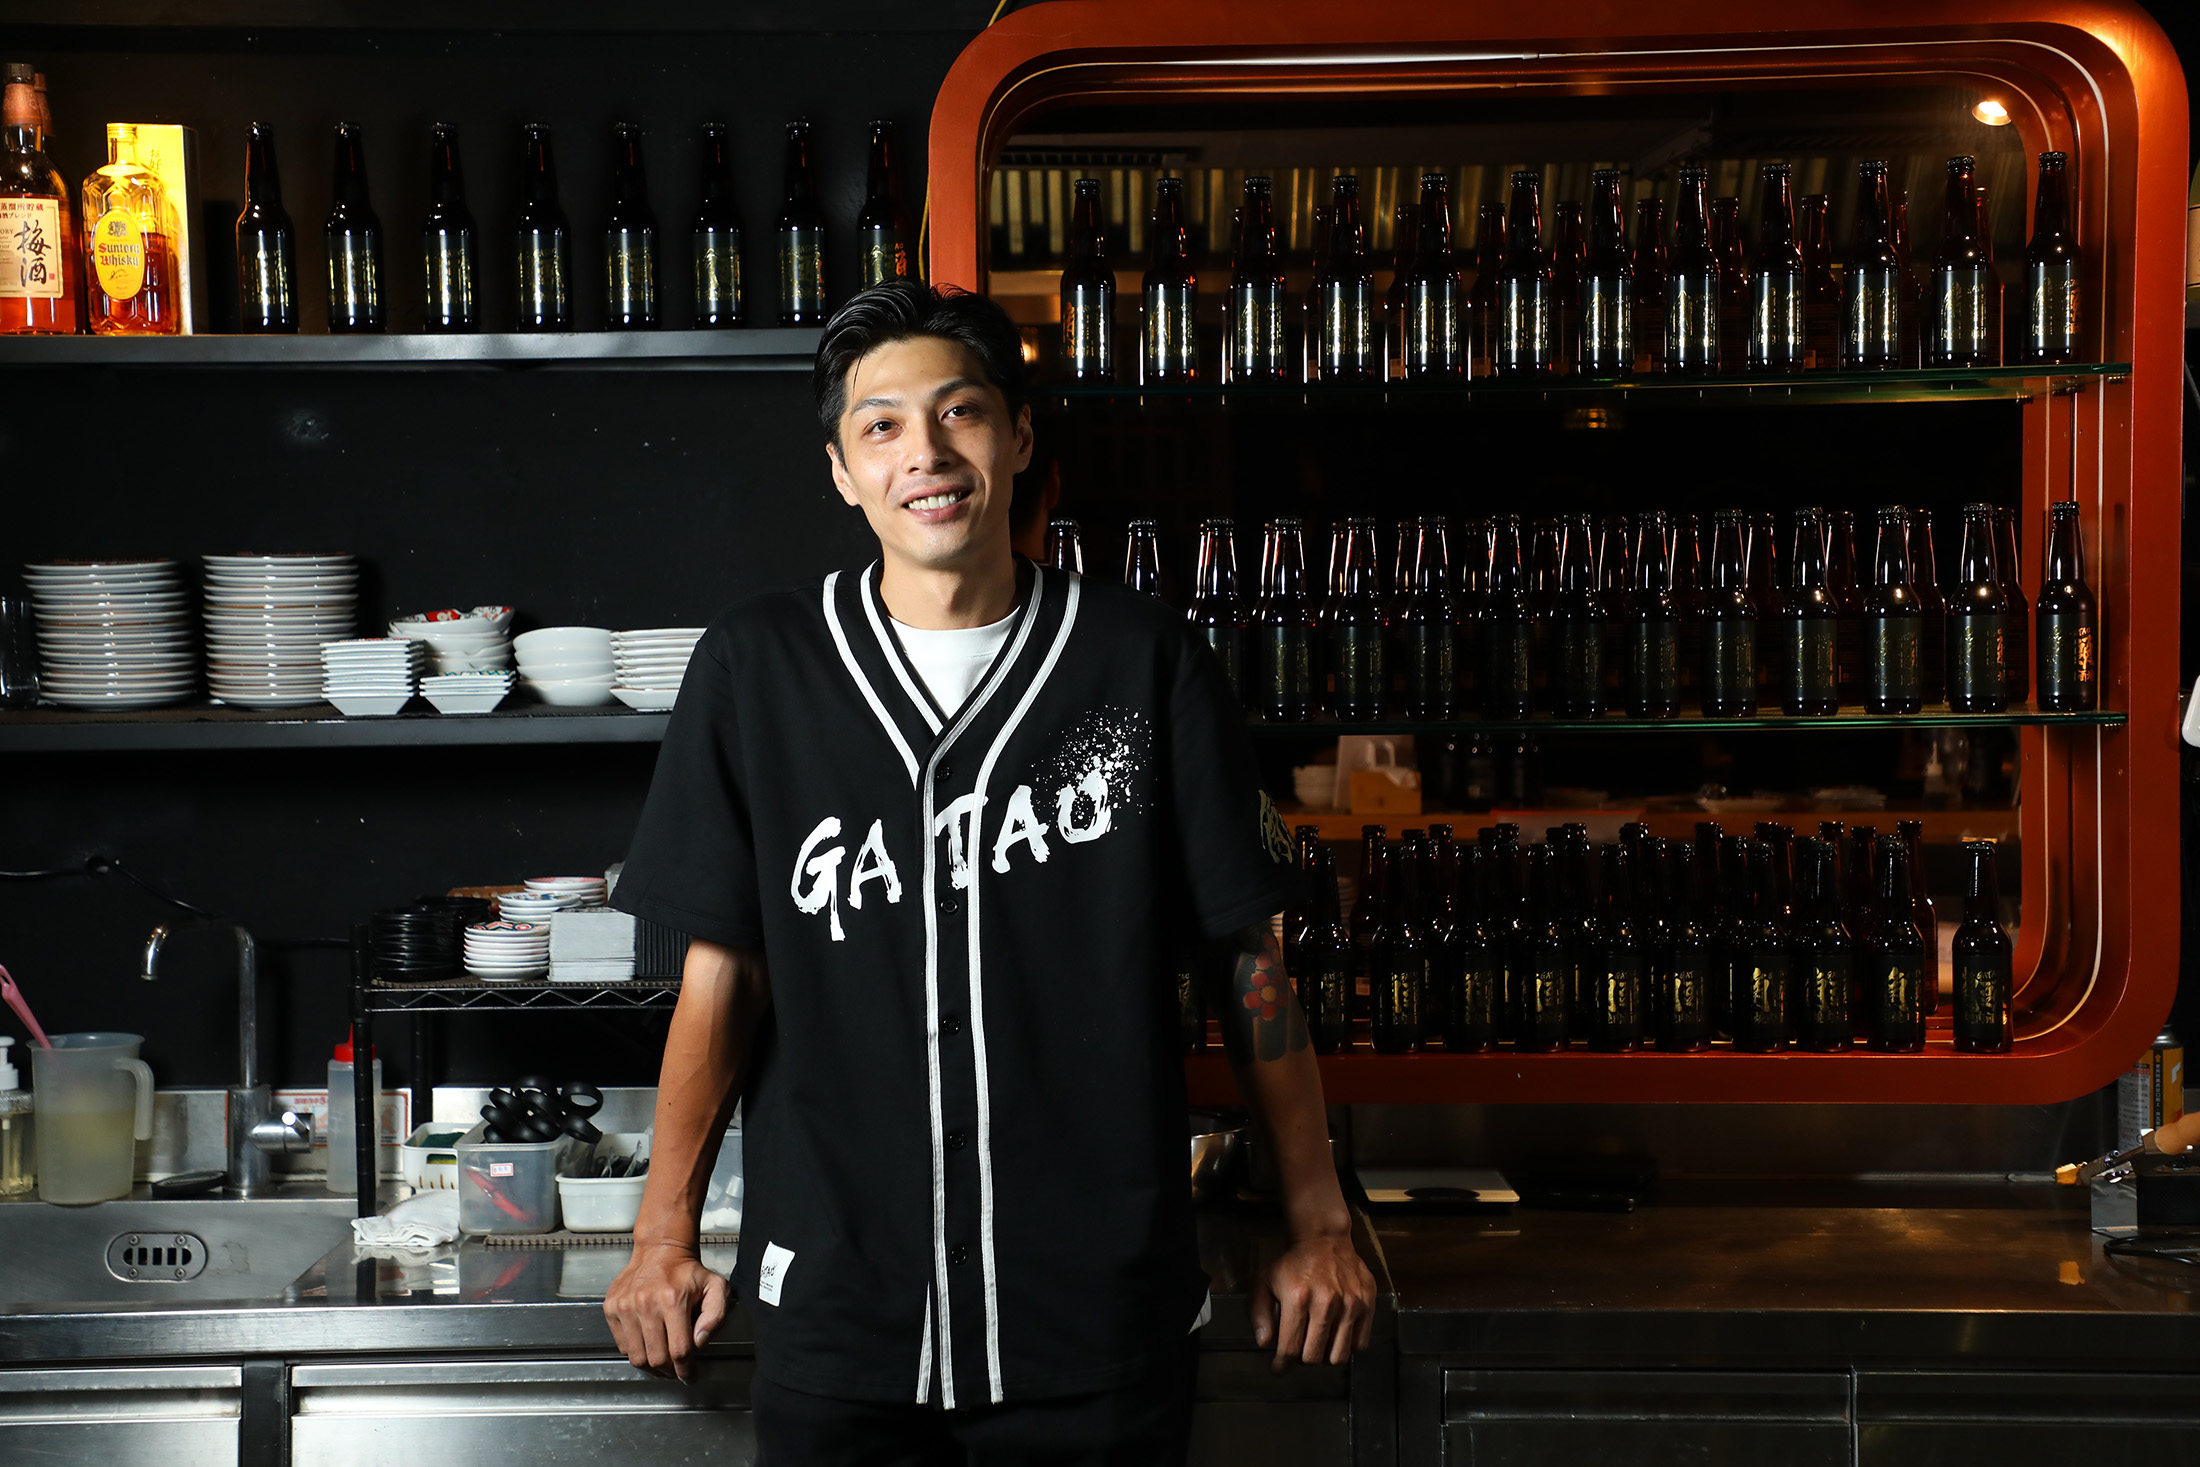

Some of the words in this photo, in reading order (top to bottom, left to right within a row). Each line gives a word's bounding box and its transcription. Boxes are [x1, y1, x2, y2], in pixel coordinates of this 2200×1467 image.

[14, 219, 52, 287] 梅酒
[98, 242, 140, 254] Suntory
[99, 254, 140, 268] Whisky
